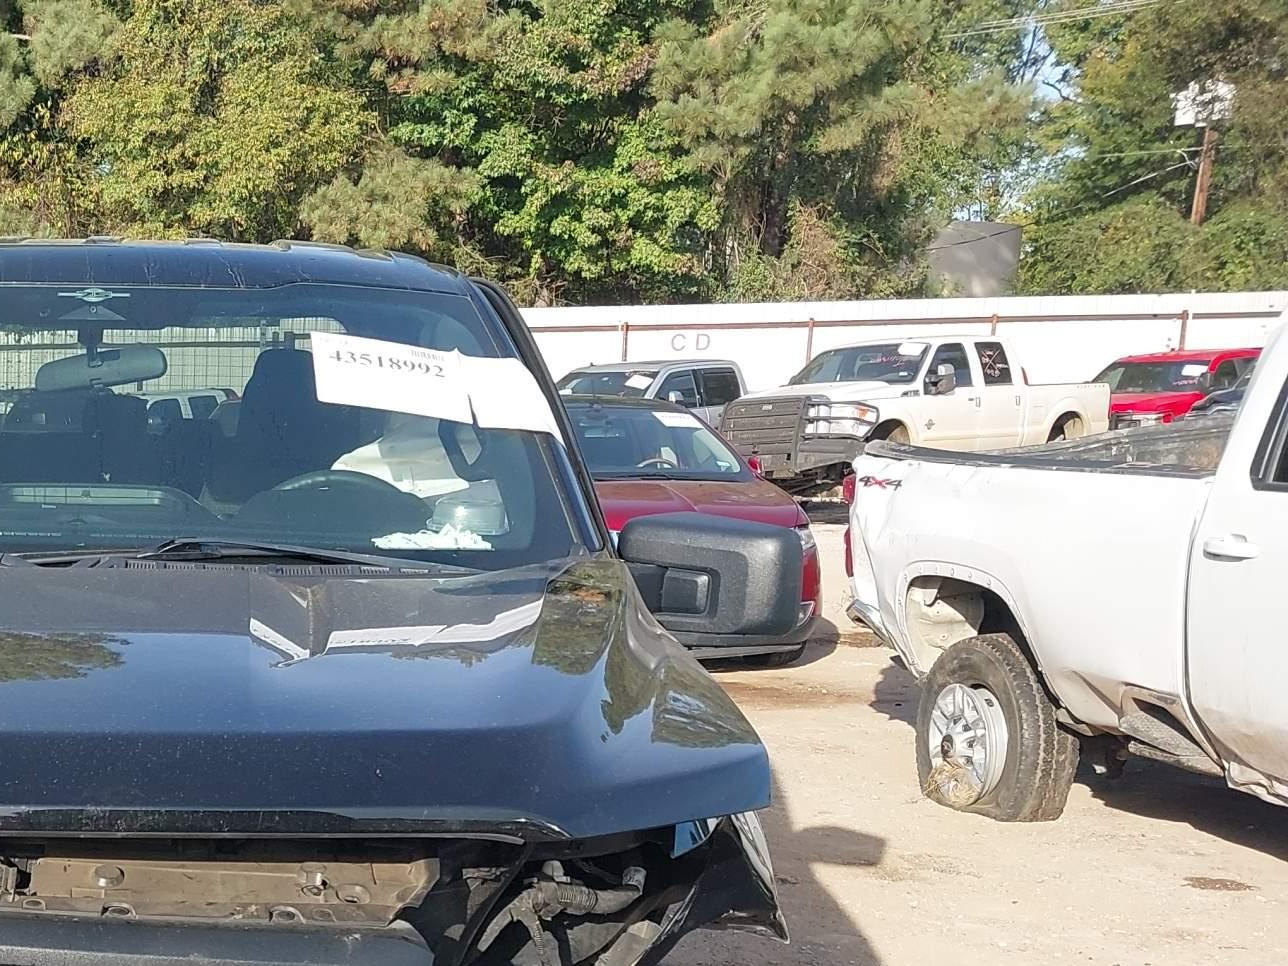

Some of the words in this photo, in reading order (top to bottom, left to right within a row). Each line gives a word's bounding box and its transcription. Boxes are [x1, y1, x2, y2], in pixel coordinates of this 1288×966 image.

[671, 333, 687, 351] C
[696, 333, 711, 351] D
[329, 348, 447, 379] 43518992
